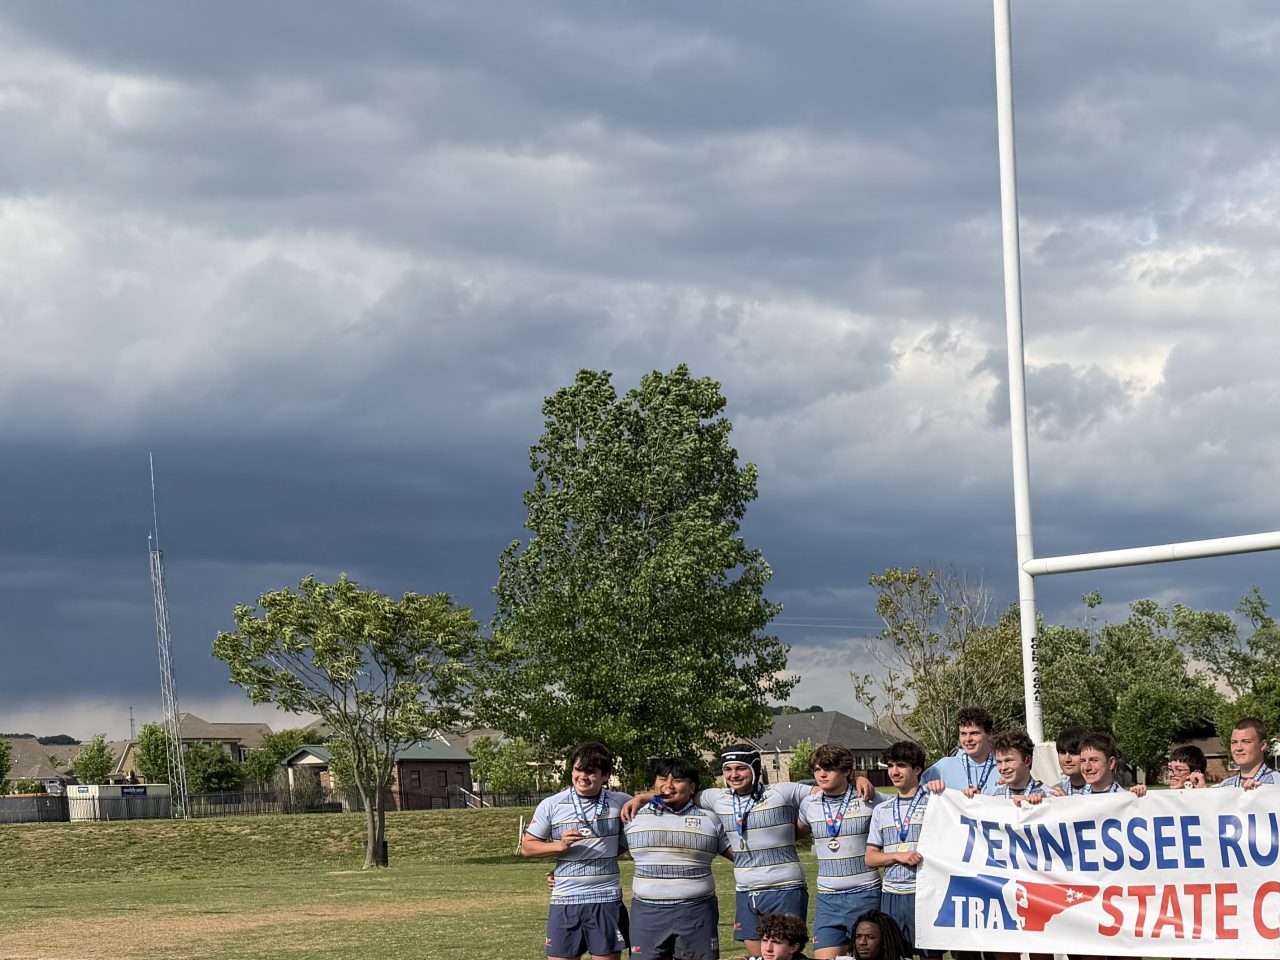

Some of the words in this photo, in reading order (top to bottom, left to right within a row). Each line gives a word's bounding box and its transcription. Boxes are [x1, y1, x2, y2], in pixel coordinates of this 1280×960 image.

[960, 815, 1205, 872] TENNESSEE
[951, 896, 1003, 930] TRA
[1097, 883, 1239, 940] STATE
